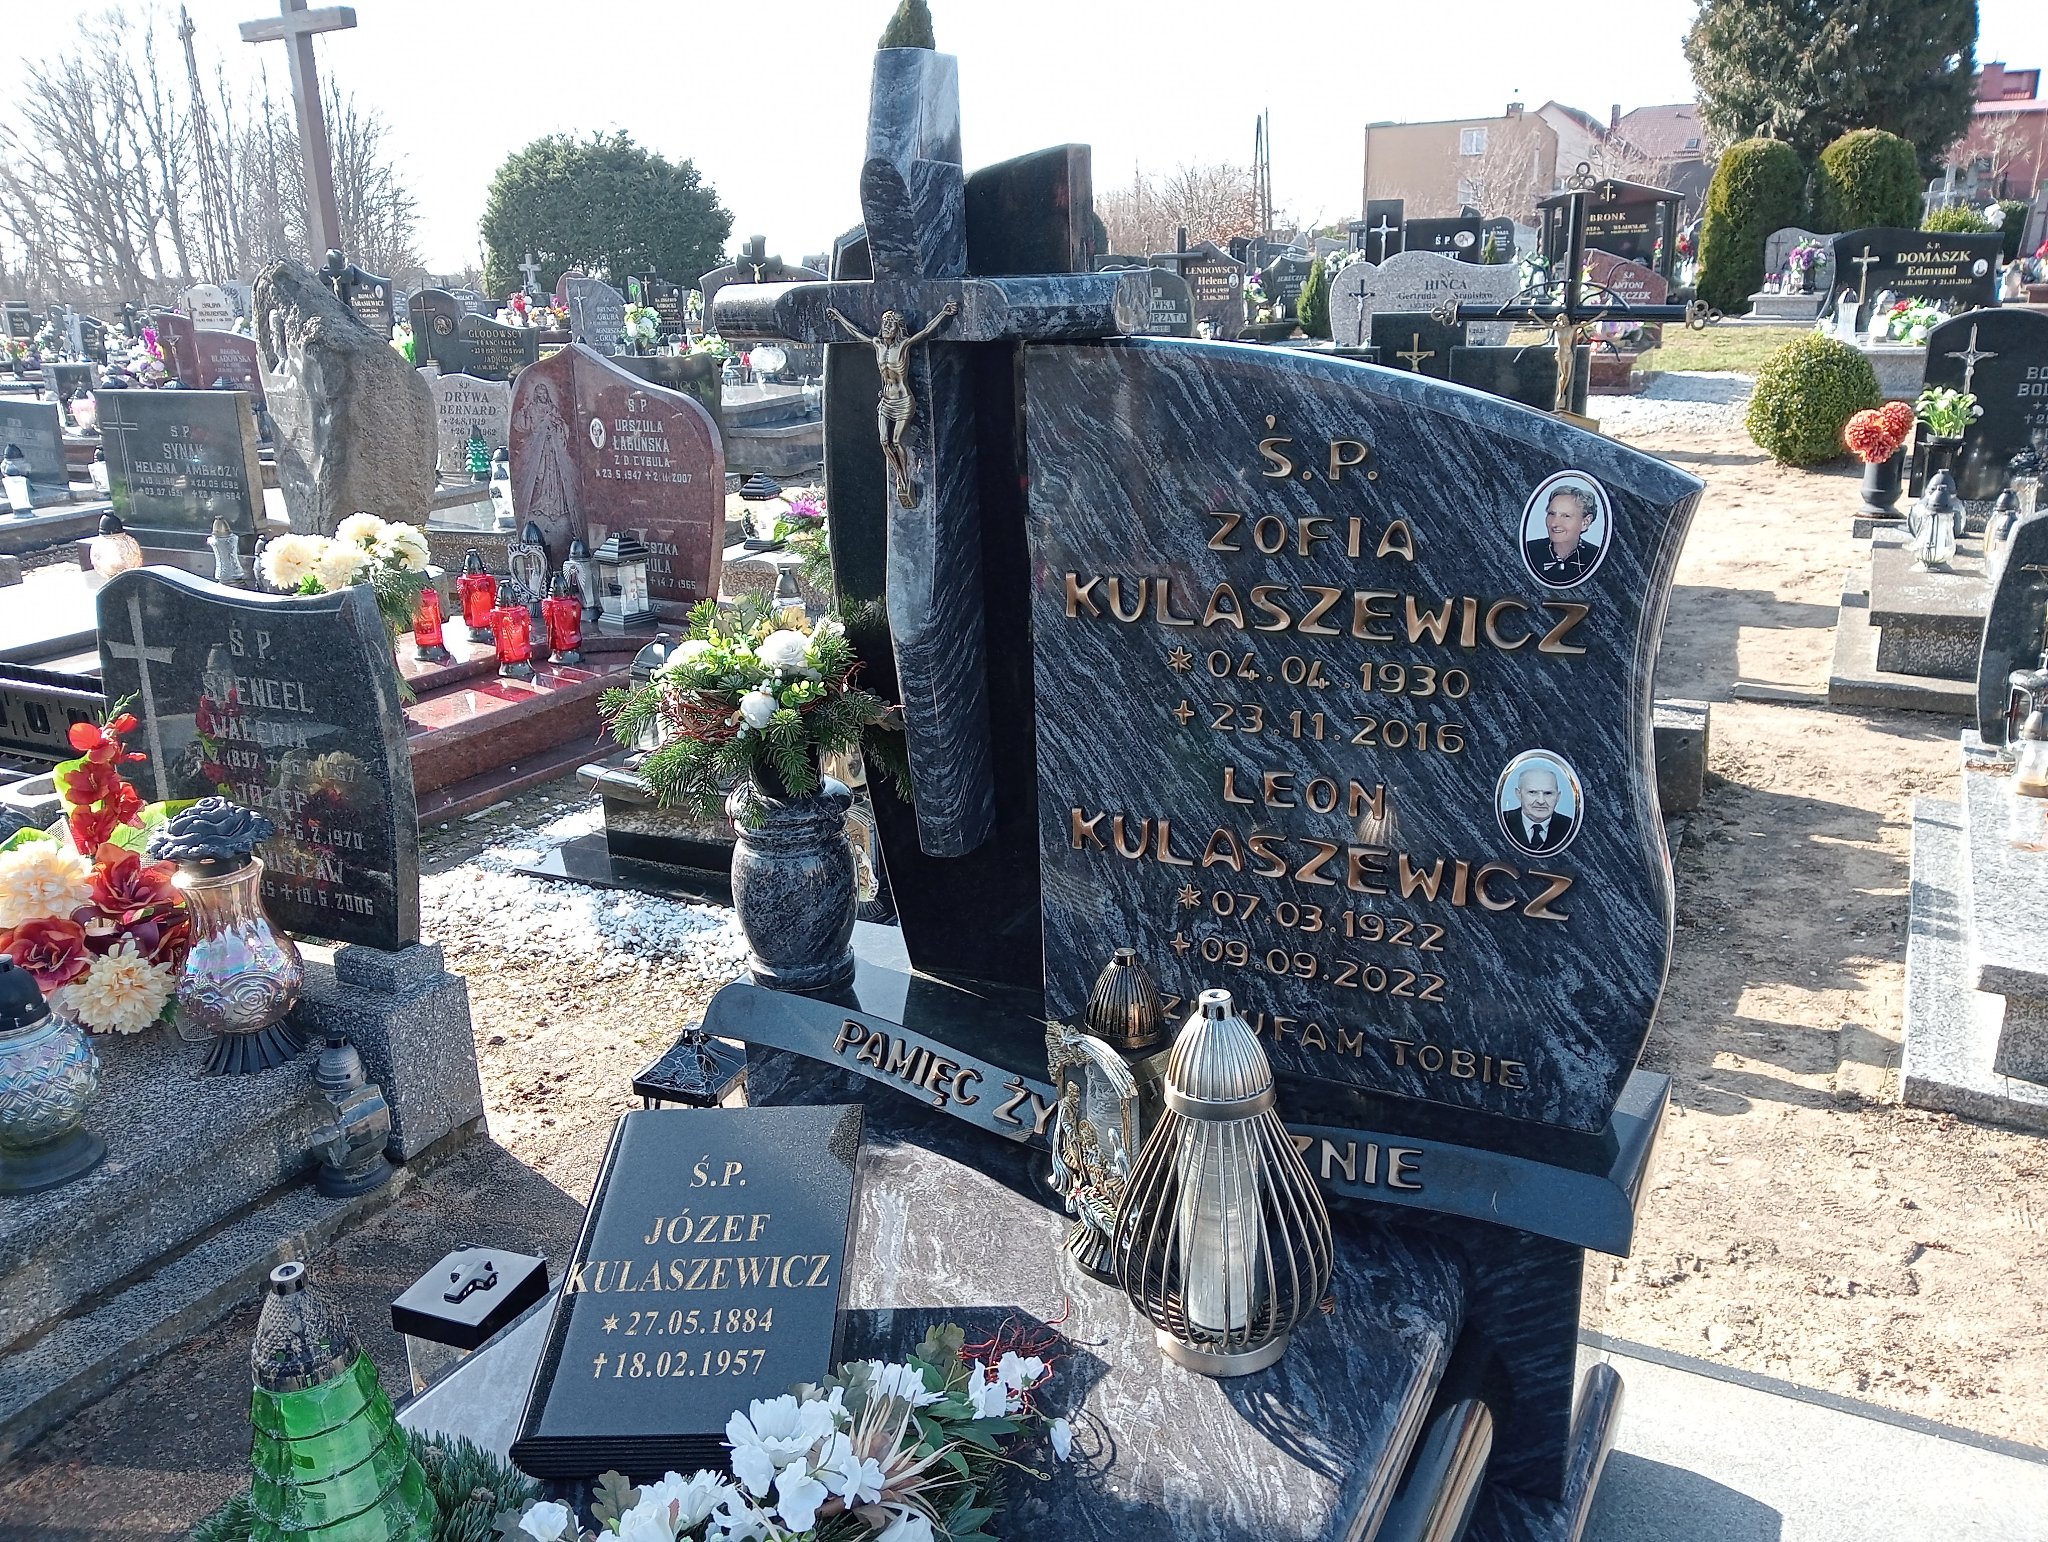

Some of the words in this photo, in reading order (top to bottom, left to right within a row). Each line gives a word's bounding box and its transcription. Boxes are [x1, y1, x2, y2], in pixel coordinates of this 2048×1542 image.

[1589, 212, 1626, 222] BRONK
[1185, 266, 1240, 275] LENDOWSCY
[1897, 250, 1971, 264] DOMASZK
[1907, 265, 1957, 276] Edmund
[1198, 276, 1228, 285] Helena
[1398, 291, 1437, 299] Gertruda
[1611, 281, 1645, 289] ANTONI
[440, 404, 497, 416] BERNARD
[444, 391, 489, 403] DRYWA
[615, 418, 664, 433] URSZULA
[612, 433, 671, 453] ŁABUŃSKA
[1257, 414, 1378, 481] Ś.P.
[135, 460, 178, 474] HELENA
[633, 455, 671, 468] CYBULA
[1207, 511, 1415, 562] ZOFIA
[1064, 569, 1591, 655] KULASZEWICZ
[1207, 649, 1472, 699] 04.04.1930
[208, 713, 310, 750] WALERIA
[1210, 701, 1466, 755] 23.11.2016
[1222, 766, 1387, 820] LEON
[1070, 806, 1575, 920] KULASZEWICZ
[1211, 889, 1446, 952] 07.03.1922
[1200, 936, 1448, 1003] 09.09.2022
[1388, 1037, 1527, 1091] TOBIE
[689, 1153, 747, 1189] Ś.P.
[643, 1207, 772, 1246] JÓZEF
[563, 1254, 832, 1297] KULASZEWICZ
[624, 1307, 774, 1337] 27.05.1884
[612, 1348, 767, 1379] 18.02.1957
